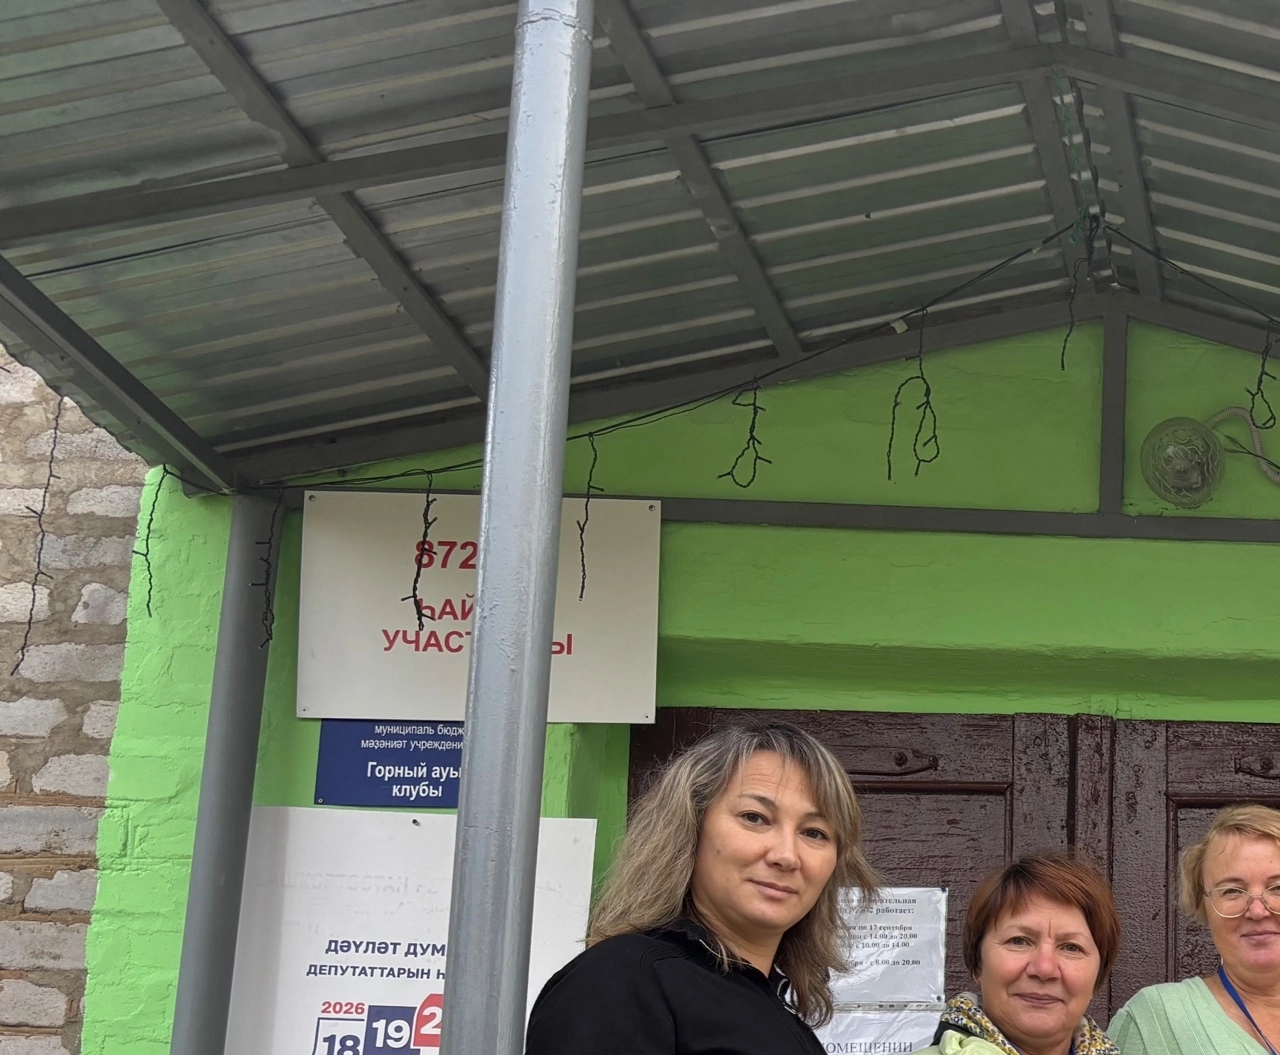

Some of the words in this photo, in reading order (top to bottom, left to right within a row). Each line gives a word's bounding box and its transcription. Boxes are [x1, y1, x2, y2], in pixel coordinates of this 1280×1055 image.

[415, 541, 478, 569] 872
[417, 593, 475, 621] ҺАЙ
[375, 725, 435, 737] муниципаль
[437, 724, 465, 737] бюдж
[410, 741, 463, 751] учреждени
[367, 761, 426, 781] Горный
[431, 766, 461, 782] ауы
[392, 782, 442, 800] клубы
[875, 907, 914, 915] работает:
[325, 940, 401, 954] ДӘҮЛӘТ
[404, 943, 446, 957] ДУМ
[306, 964, 431, 979] ДЕПУТАТТАРЫН
[321, 1001, 365, 1015] 2026
[372, 1019, 411, 1048] 19
[420, 1006, 443, 1034] 2
[823, 1042, 913, 1054] ОМЕЩЕНИИ
